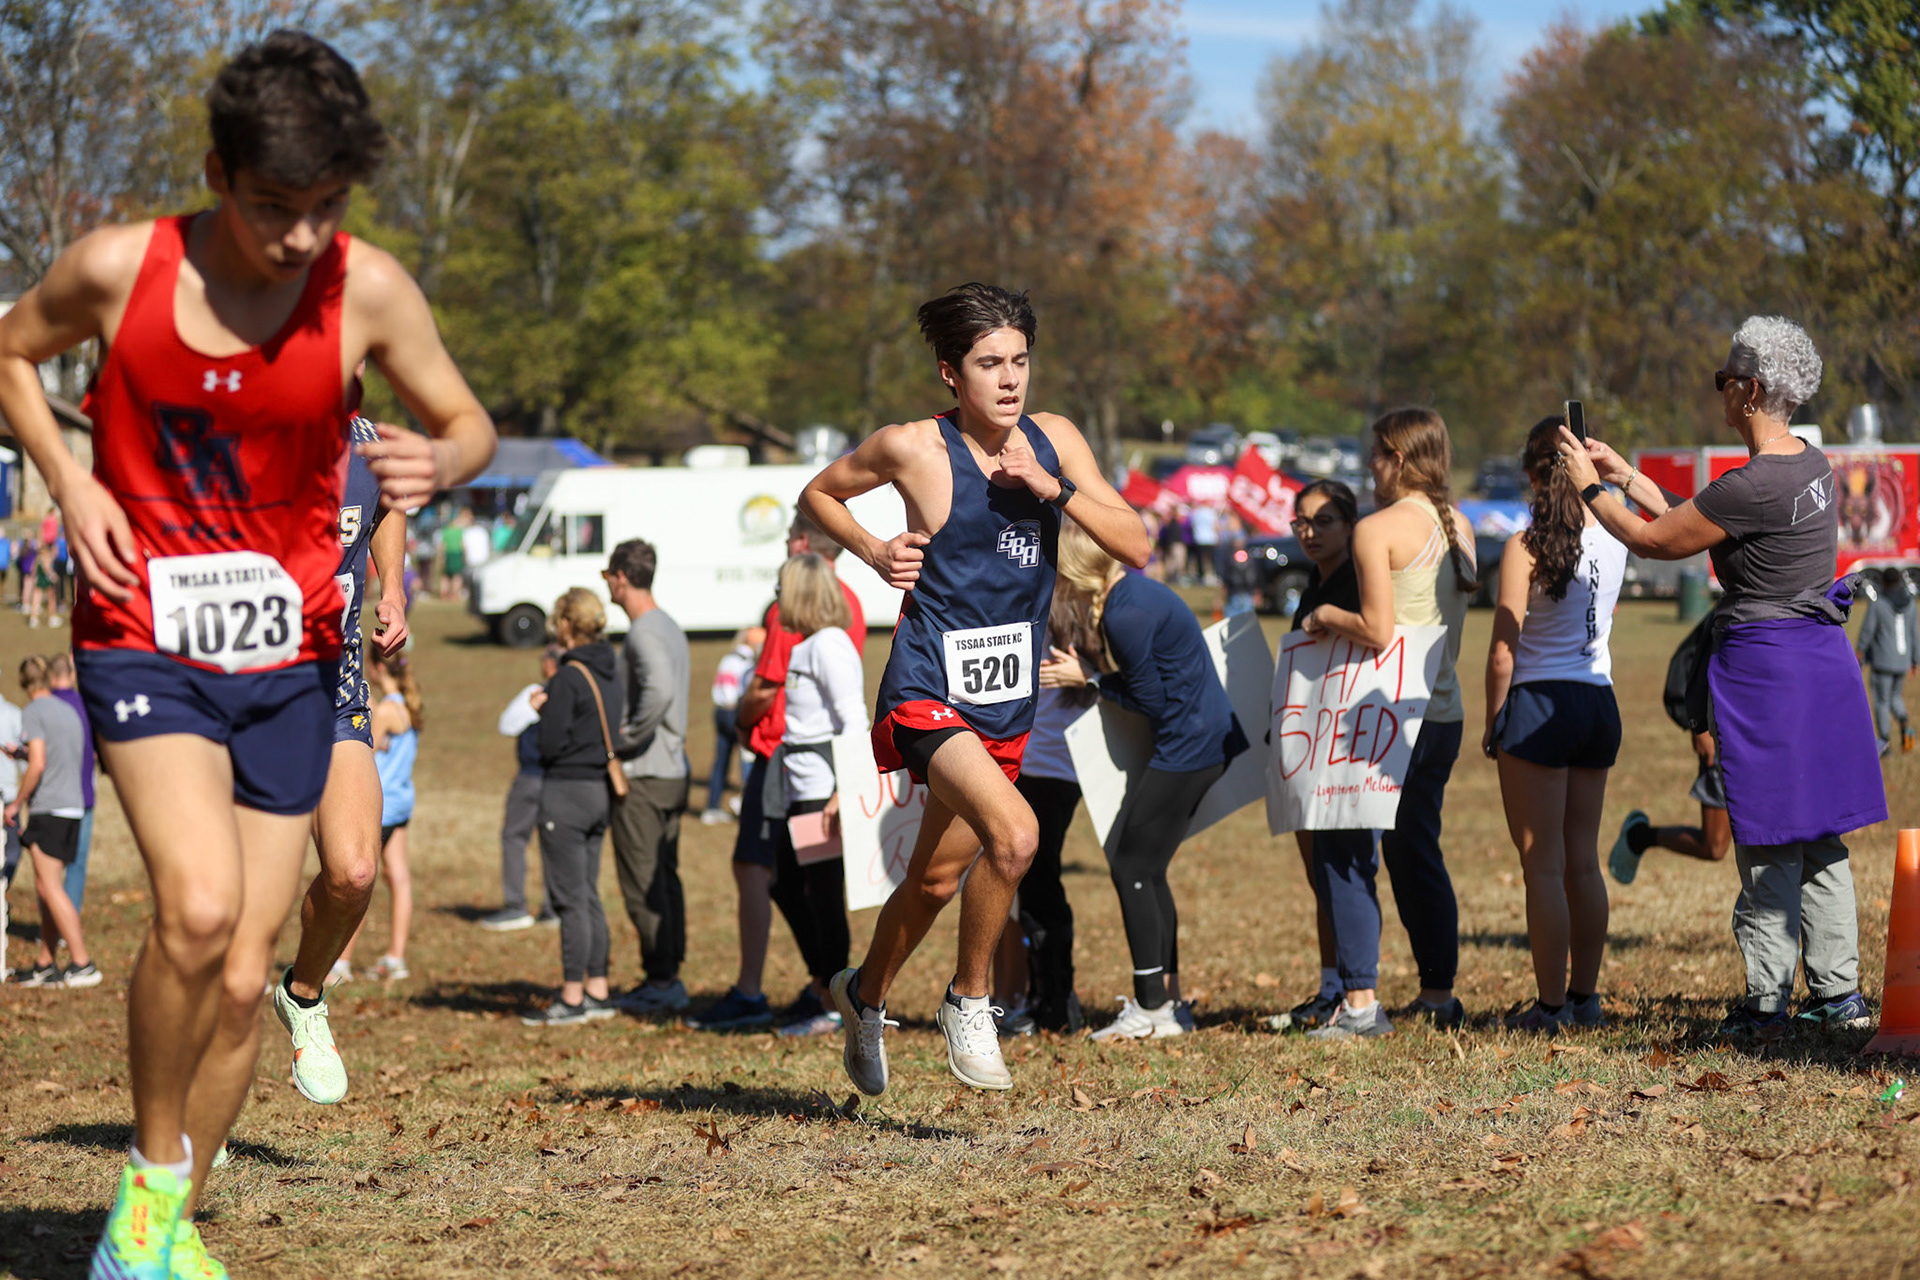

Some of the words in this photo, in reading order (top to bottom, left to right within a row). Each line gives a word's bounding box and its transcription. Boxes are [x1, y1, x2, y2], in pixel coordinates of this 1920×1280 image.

[998, 530, 1039, 567] SBA
[167, 596, 289, 658] 1023
[955, 638, 985, 651] TSSAA
[987, 633, 1011, 648] STATE
[1012, 632, 1023, 645] XC
[962, 653, 1020, 695] 520
[1274, 640, 1317, 716] I
[1320, 634, 1405, 704] AM
